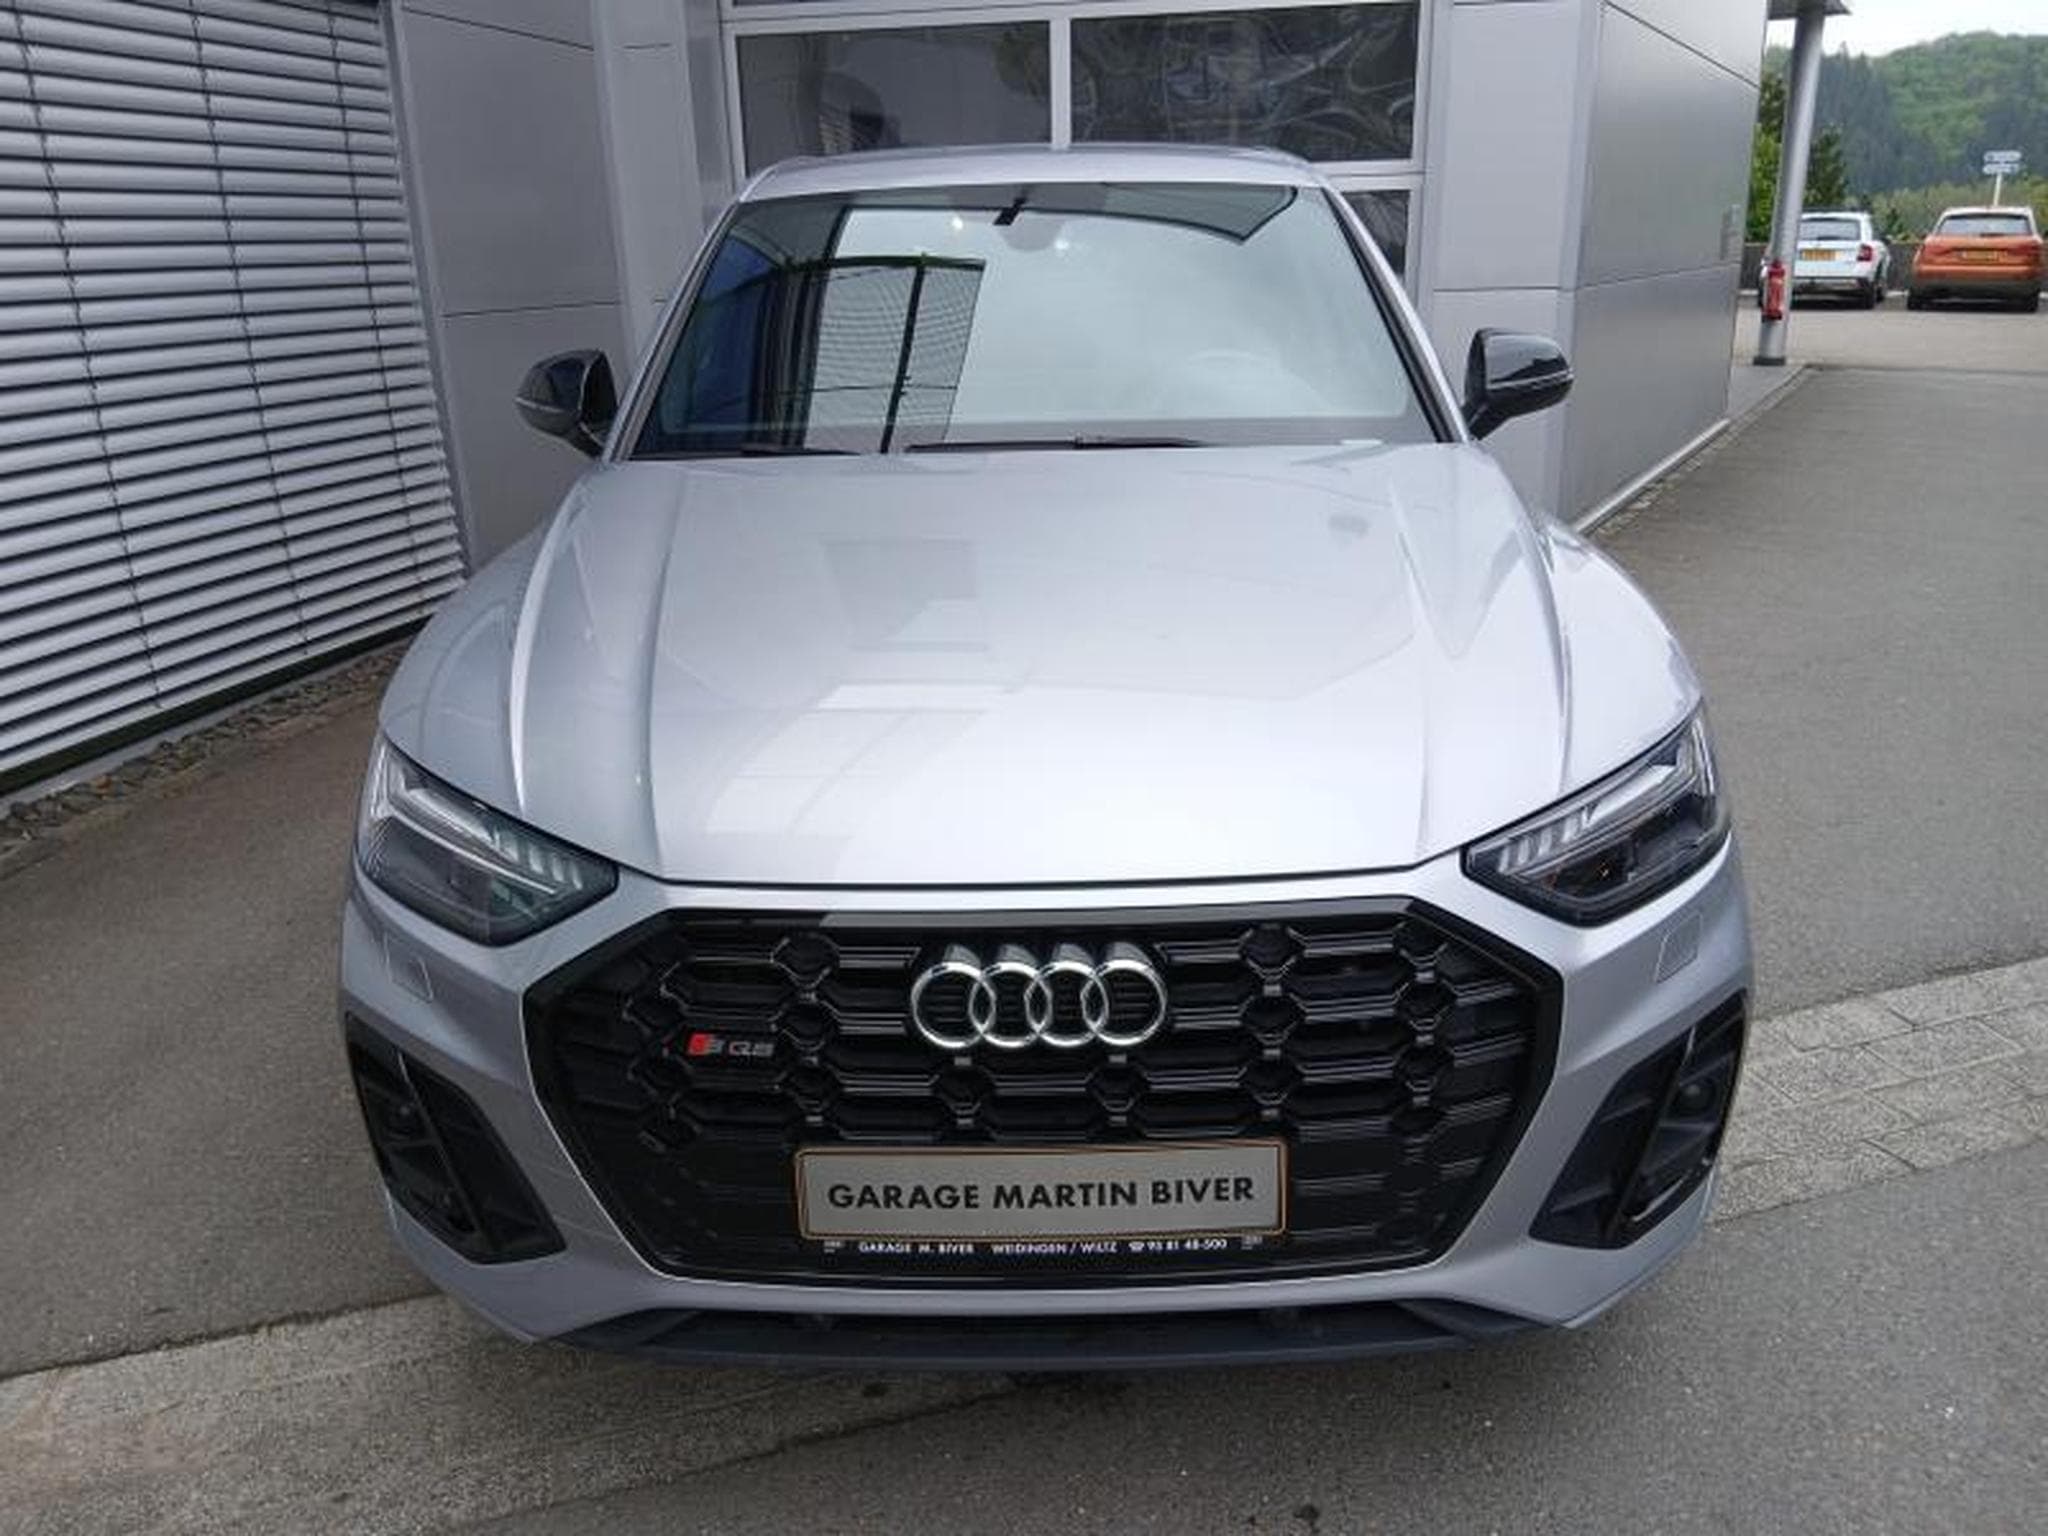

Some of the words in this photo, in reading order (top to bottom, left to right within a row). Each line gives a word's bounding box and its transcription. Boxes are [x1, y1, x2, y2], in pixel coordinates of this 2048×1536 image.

[828, 1184, 980, 1209] GARAGE
[993, 1181, 1137, 1209] MARTIN
[1151, 1177, 1254, 1204] BIVER
[859, 1242, 912, 1254] GARAGE
[939, 1243, 975, 1254] BIVER
